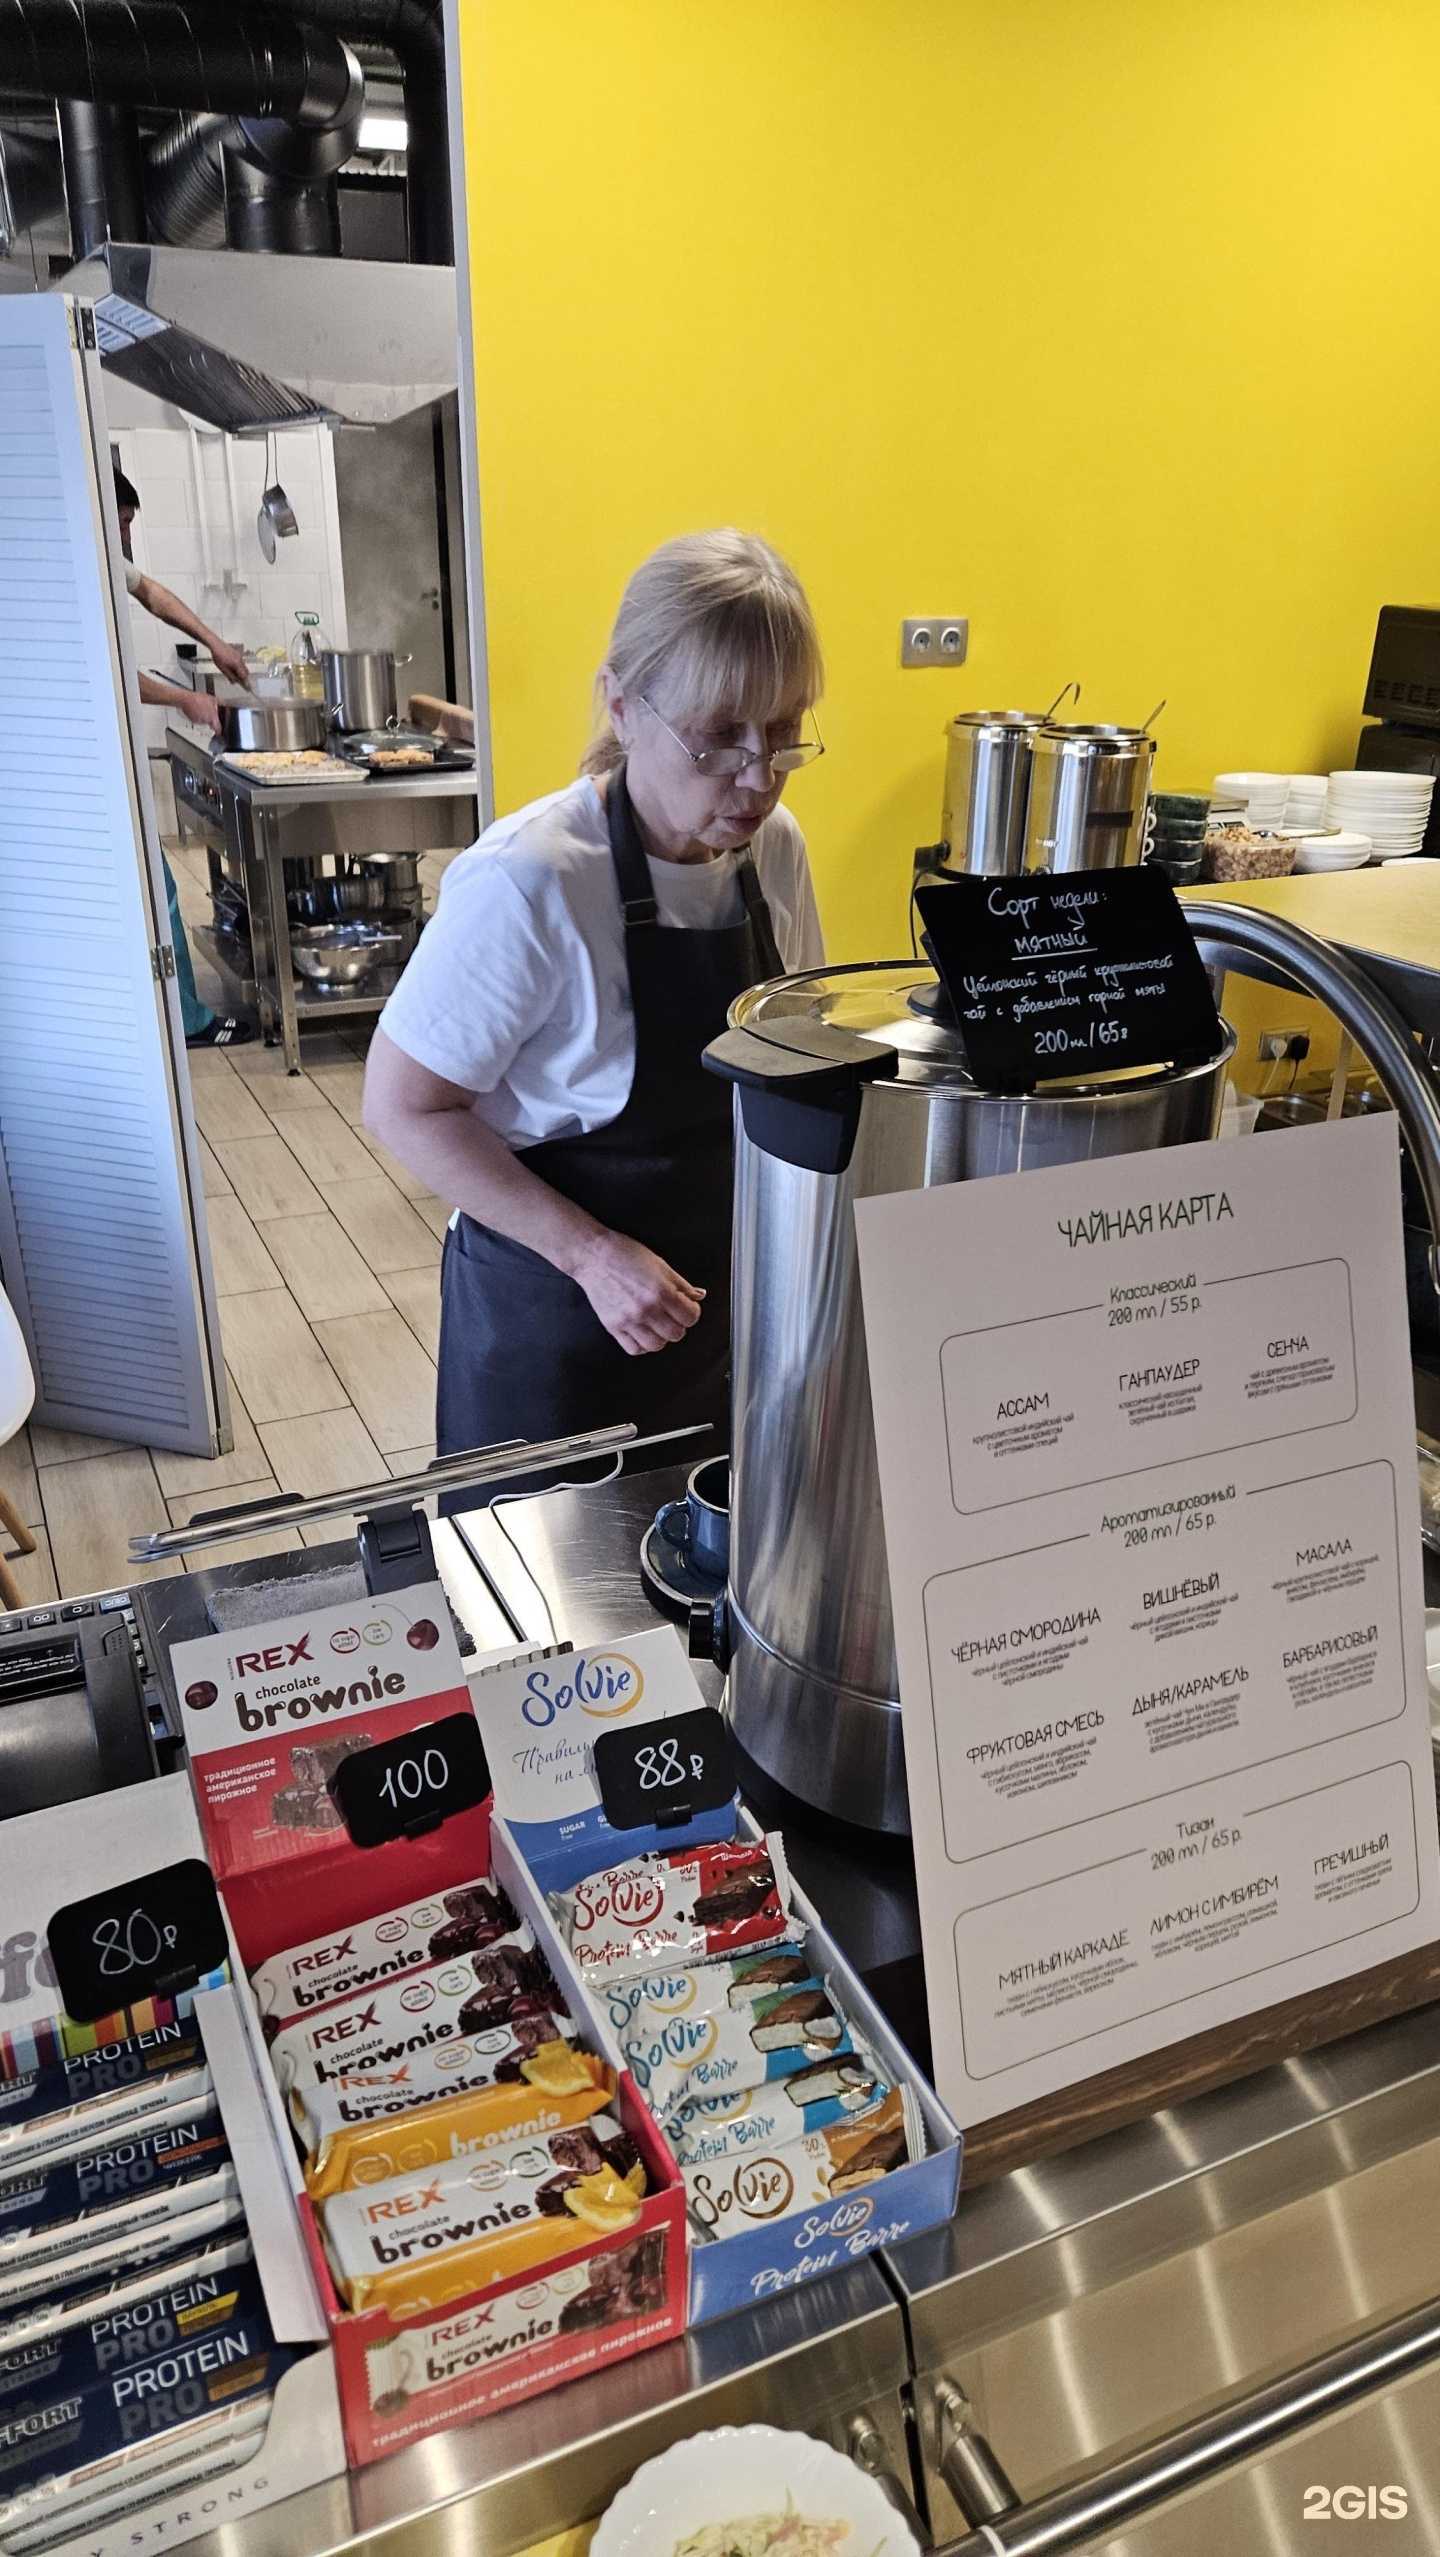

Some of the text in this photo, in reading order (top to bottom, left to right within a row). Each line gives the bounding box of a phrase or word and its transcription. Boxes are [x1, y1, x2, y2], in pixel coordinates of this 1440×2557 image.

[987, 887, 1040, 929] Сорт
[964, 1002, 986, 1020] чай
[1057, 1192, 1234, 1248] ЧАЙНАЯ КАРТА
[1110, 1272, 1197, 1304] Классический
[1108, 1306, 1132, 1327] 200
[1170, 1295, 1189, 1314] 55
[1266, 1335, 1310, 1359] СЕНЧА
[1119, 1358, 1200, 1392] ГАНПАУДЕР
[996, 1391, 1050, 1421] АССАМ
[1100, 1484, 1236, 1533] Ароматизированный
[1123, 1528, 1148, 1549] 200
[1185, 1511, 1204, 1532] 65
[1295, 1538, 1353, 1567] МАСАЛА
[1142, 1571, 1220, 1610] ВИШНЁВЫЙ
[235, 1632, 315, 1678] REX
[951, 1632, 1008, 1664] ЧЁРНАЯ
[1010, 1607, 1102, 1648] СМОРОДИНА
[1282, 1624, 1378, 1669] БАРБАРИСОВЫЙ
[234, 1664, 407, 1732] brownie
[255, 1673, 322, 1701] chocolate
[1131, 1666, 1250, 1716] ДЫНЯ/КАРАМЕЛЬ
[965, 1723, 1053, 1764] ФРУКТОВАЯ
[1055, 1710, 1105, 1738] СМЕСЬ
[203, 1757, 277, 1784] традиционное
[205, 1767, 278, 1793] американское
[378, 1749, 449, 1808] 100
[207, 1783, 258, 1804] пирожное
[558, 1816, 587, 1835] SUGAR
[1176, 1816, 1216, 1840] Тизан
[1151, 1848, 1176, 1871] 200
[1211, 1829, 1230, 1849] 65
[1313, 1832, 1390, 1876] ГРЕЧИШНЫЙ
[1150, 1905, 1200, 1937] ЛИМОН
[1202, 1899, 1211, 1916] С
[1212, 1874, 1280, 1914] ИМБИРЁМ
[292, 1934, 358, 1977] REX
[292, 1946, 425, 2008] brownie
[307, 1963, 359, 1989] chocolate
[998, 1950, 1062, 1993] МЯТНЫЙ
[1064, 1927, 1132, 1967] КАРКАДЕ
[63, 2021, 183, 2075] PROTEIN
[311, 2001, 382, 2050] REX
[312, 2022, 455, 2085] brownie
[329, 2036, 385, 2065] chocolate
[67, 2053, 142, 2100] PRO
[337, 2073, 489, 2124] brownie
[338, 2064, 413, 2092] REX
[355, 2086, 414, 2106] chocolate
[76, 2123, 199, 2178] PROTEIN
[450, 2108, 562, 2159] brownie
[728, 2115, 776, 2145] Barre
[78, 2158, 154, 2202] PRO
[367, 2178, 447, 2225] REX
[369, 2201, 533, 2265] brownie
[387, 2214, 451, 2242] chocolate
[91, 2276, 220, 2343] PROTEIN
[430, 2302, 496, 2348] REX
[95, 2318, 175, 2371] PRO
[424, 2317, 554, 2383] brownie
[440, 2333, 494, 2361] chocolate
[112, 2330, 250, 2408] PROTEIN
[371, 2395, 486, 2449] традиционное
[489, 2348, 597, 2400] американское
[599, 2316, 674, 2356] пирожное
[118, 2380, 201, 2441] PRO
[130, 2477, 269, 2545] STRONG
